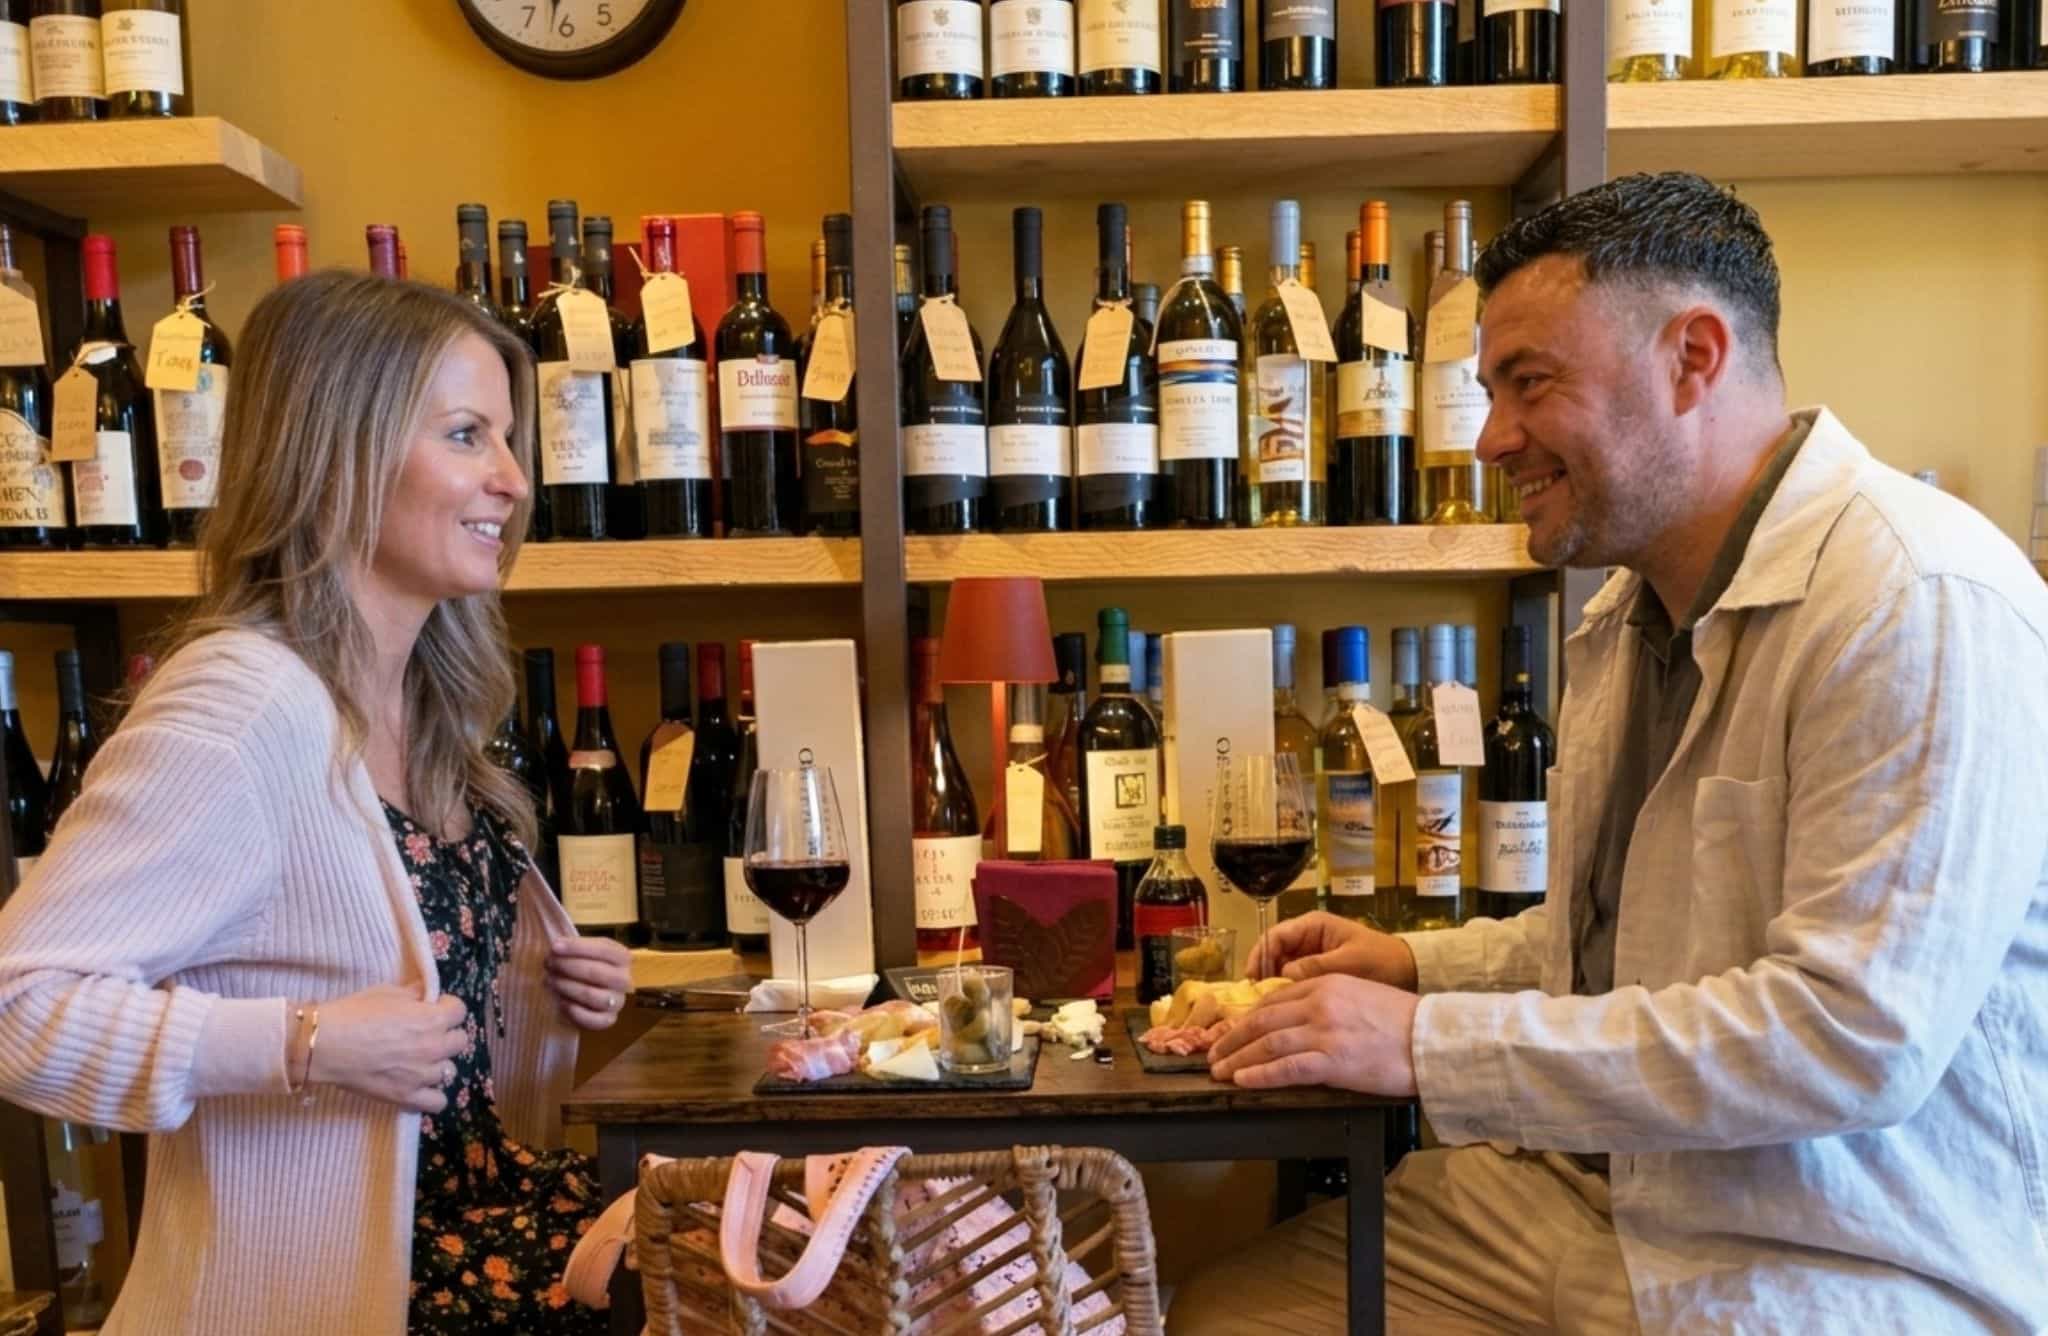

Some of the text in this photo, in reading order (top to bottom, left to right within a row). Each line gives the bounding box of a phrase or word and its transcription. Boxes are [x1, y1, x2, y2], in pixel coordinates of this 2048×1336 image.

[521, 6, 536, 28] 7
[597, 4, 612, 26] 5
[558, 15, 575, 38] 6
